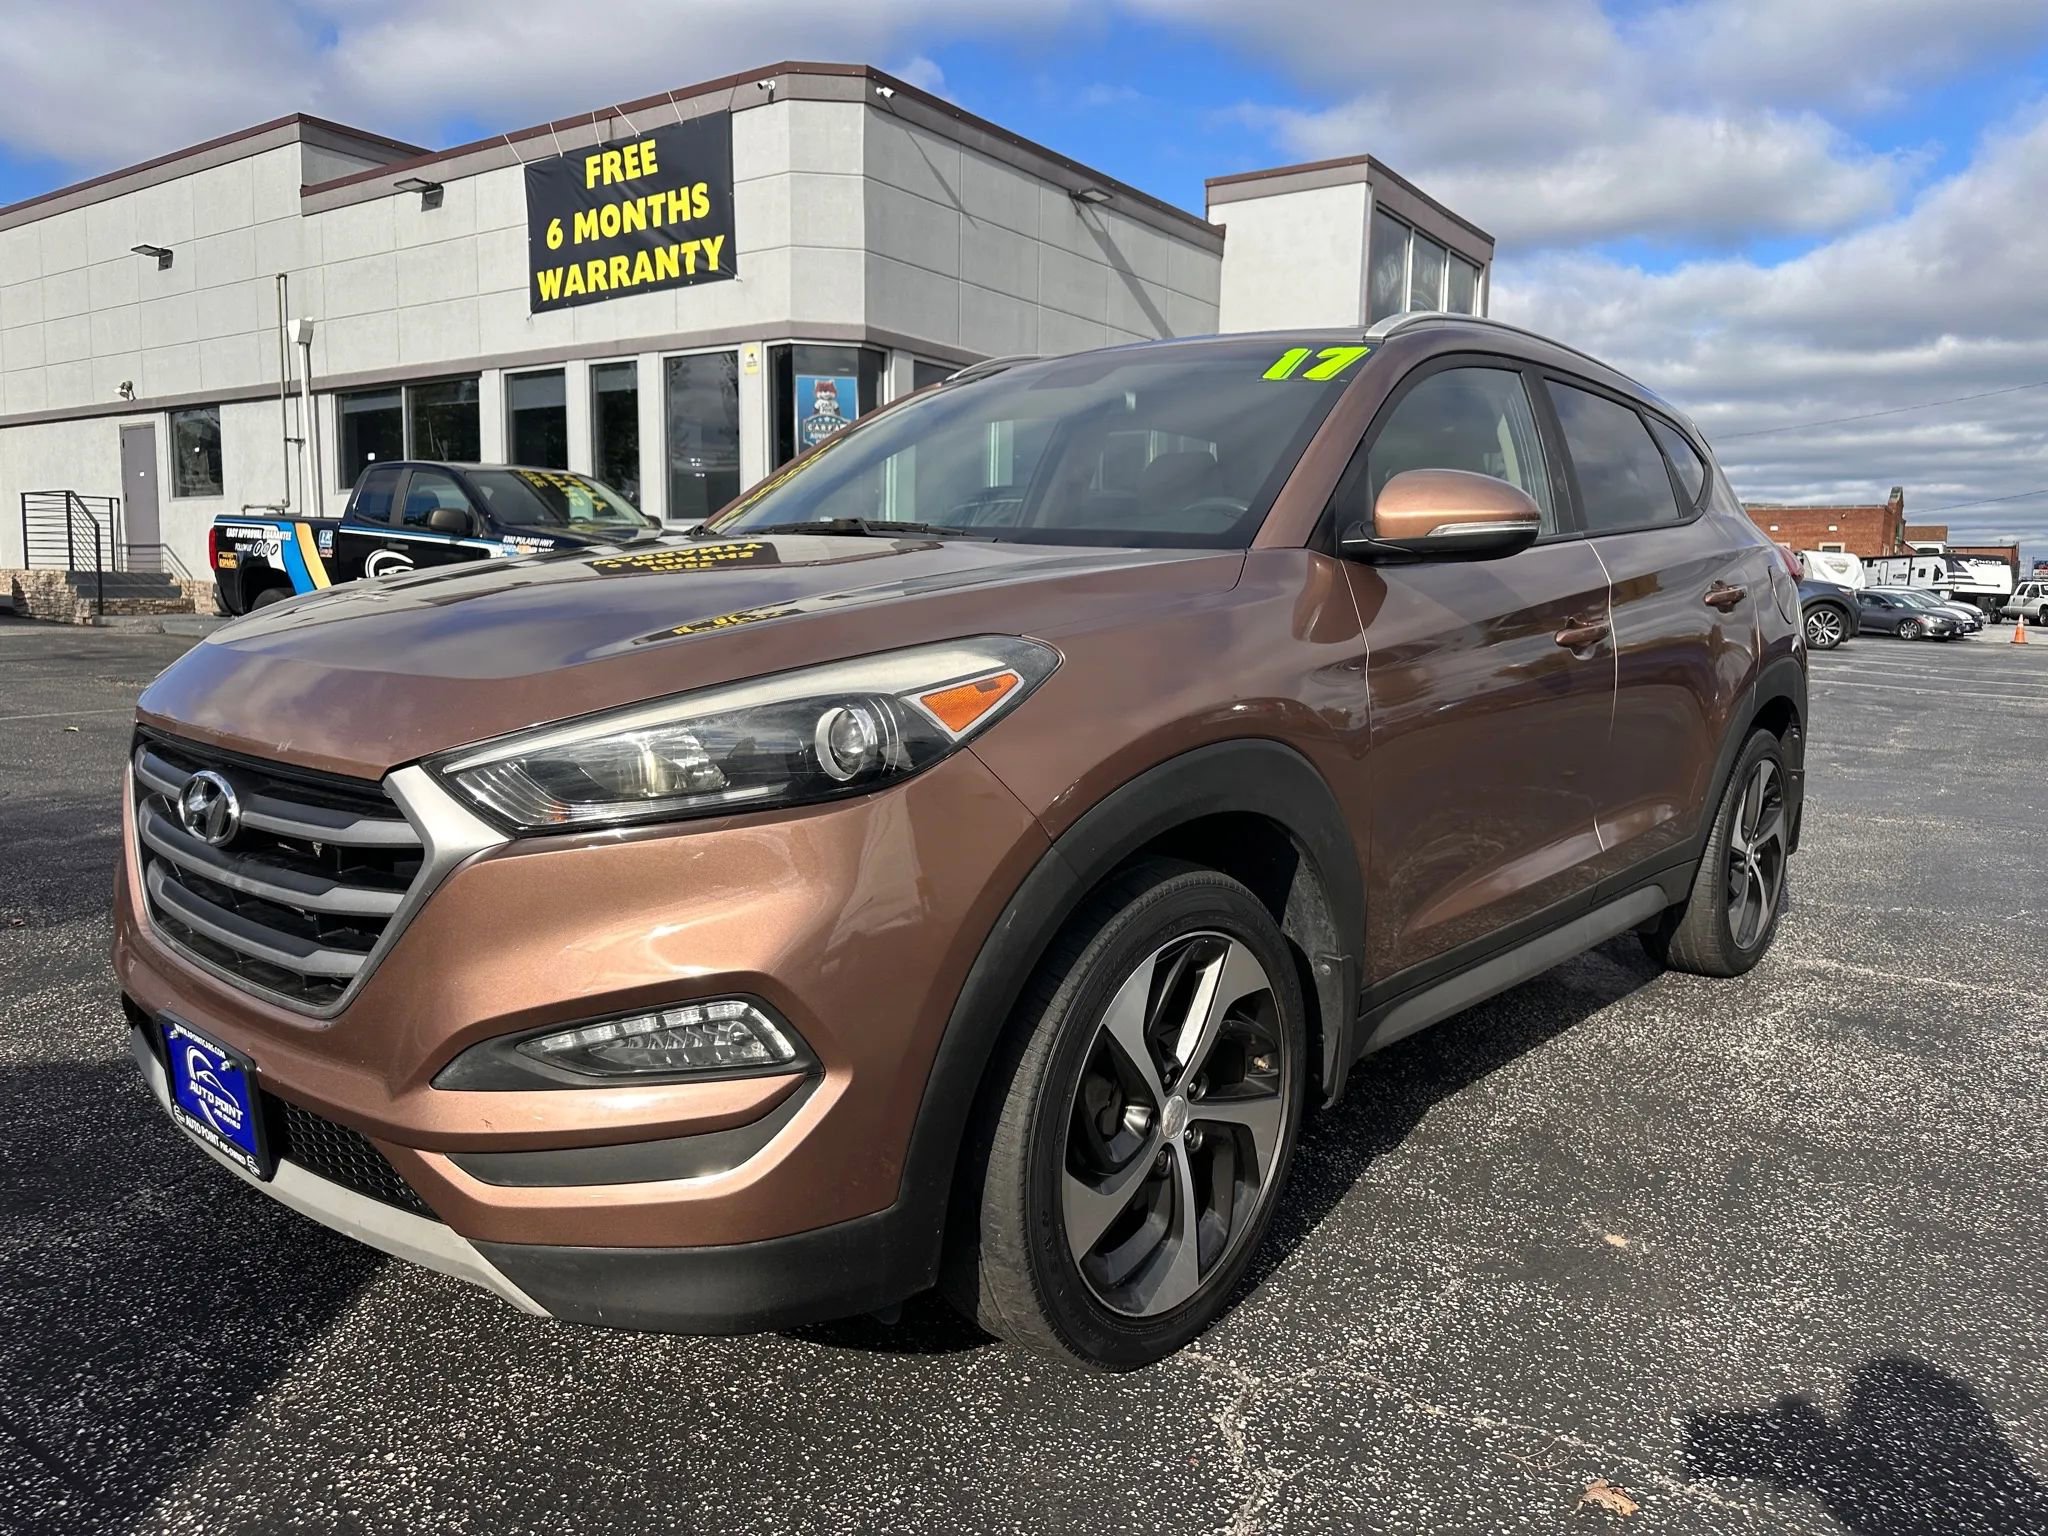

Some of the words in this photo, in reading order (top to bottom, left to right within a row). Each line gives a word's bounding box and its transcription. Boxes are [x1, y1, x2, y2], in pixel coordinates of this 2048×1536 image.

[585, 139, 658, 189] FREE
[546, 218, 563, 250] 6
[574, 182, 710, 245] MONTHS
[537, 234, 725, 301] WARRANTY
[1262, 346, 1371, 381] 17
[190, 1080, 214, 1103] AUTO
[215, 1095, 244, 1121] POINT
[186, 1115, 201, 1134] AUTO
[201, 1125, 219, 1146] POINT
